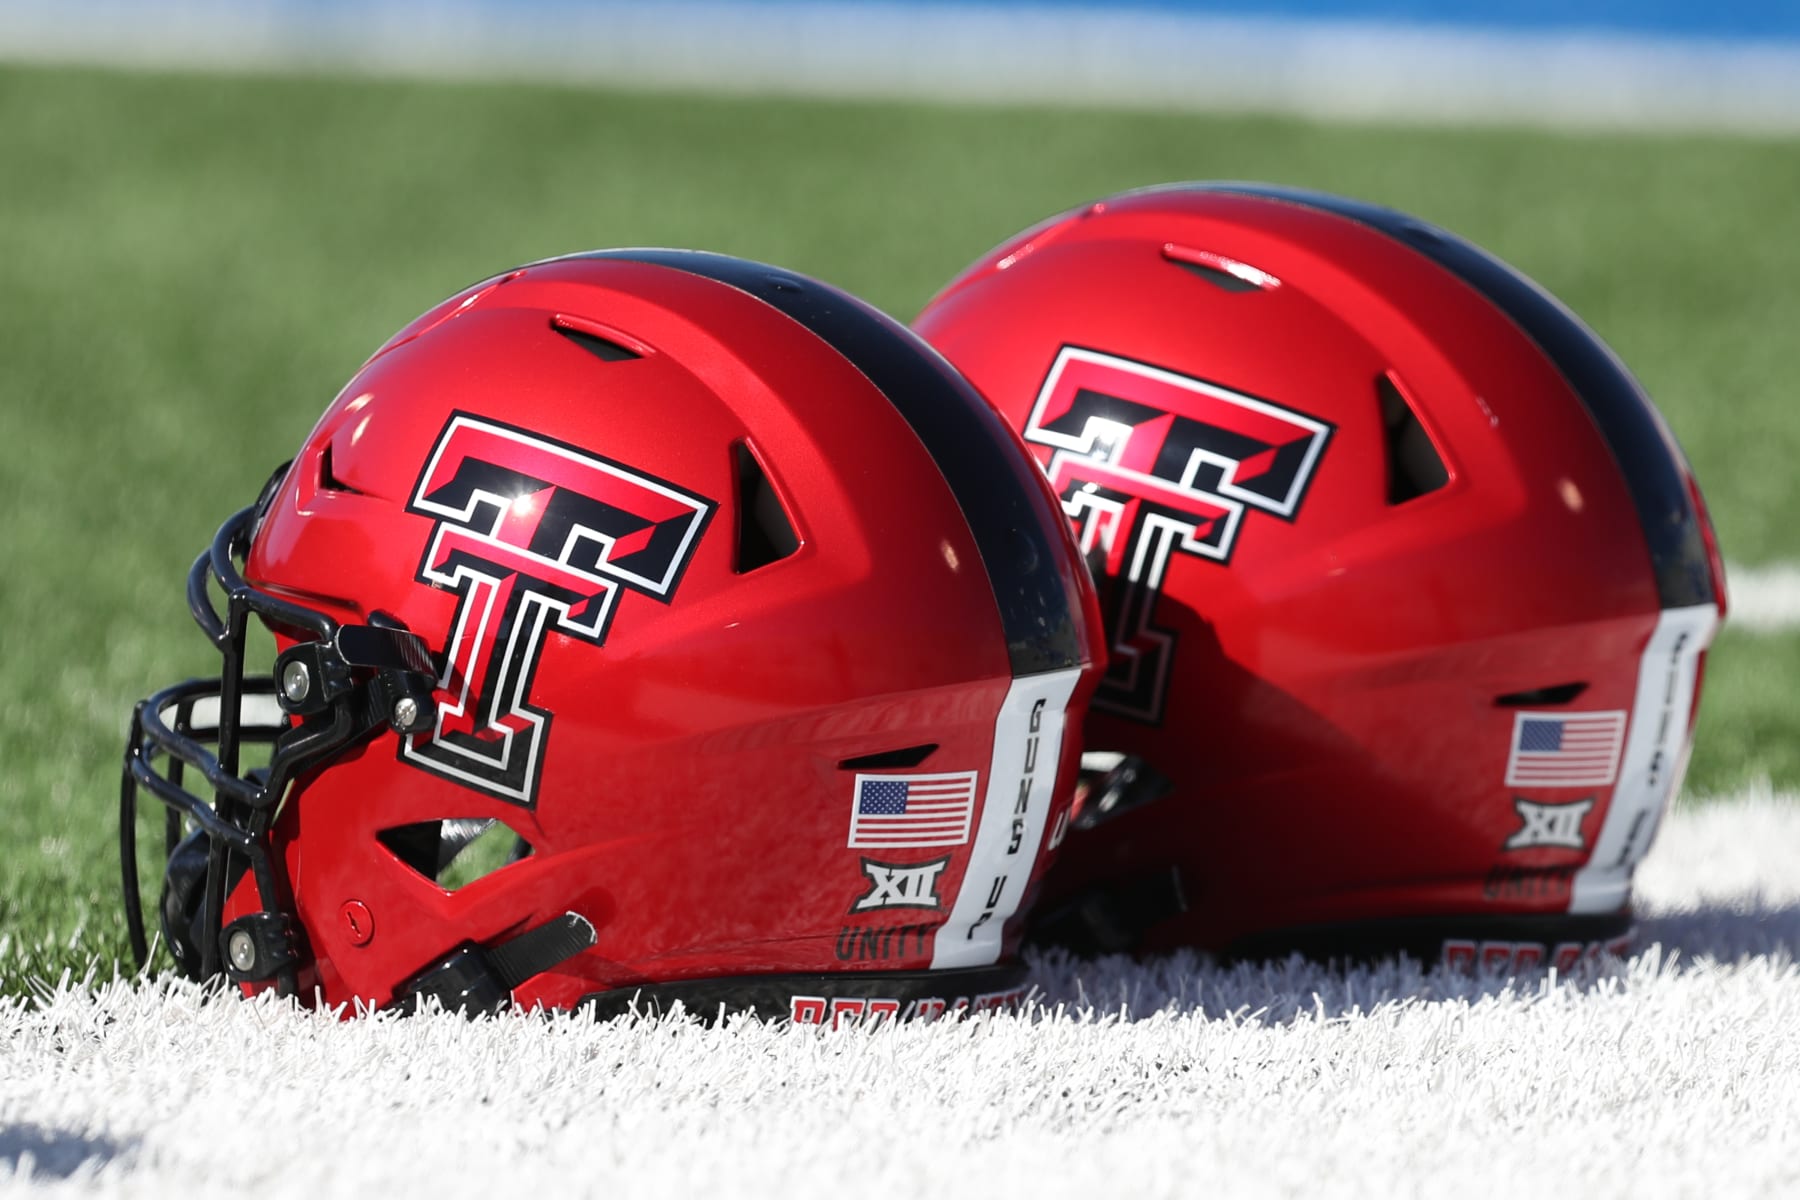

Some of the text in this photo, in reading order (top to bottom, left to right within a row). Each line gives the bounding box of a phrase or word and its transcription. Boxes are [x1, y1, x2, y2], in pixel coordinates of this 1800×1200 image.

[967, 698, 1047, 940] GUNS UP
[1500, 796, 1594, 851] XII
[849, 854, 951, 914] XII
[836, 922, 942, 960] UNITY
